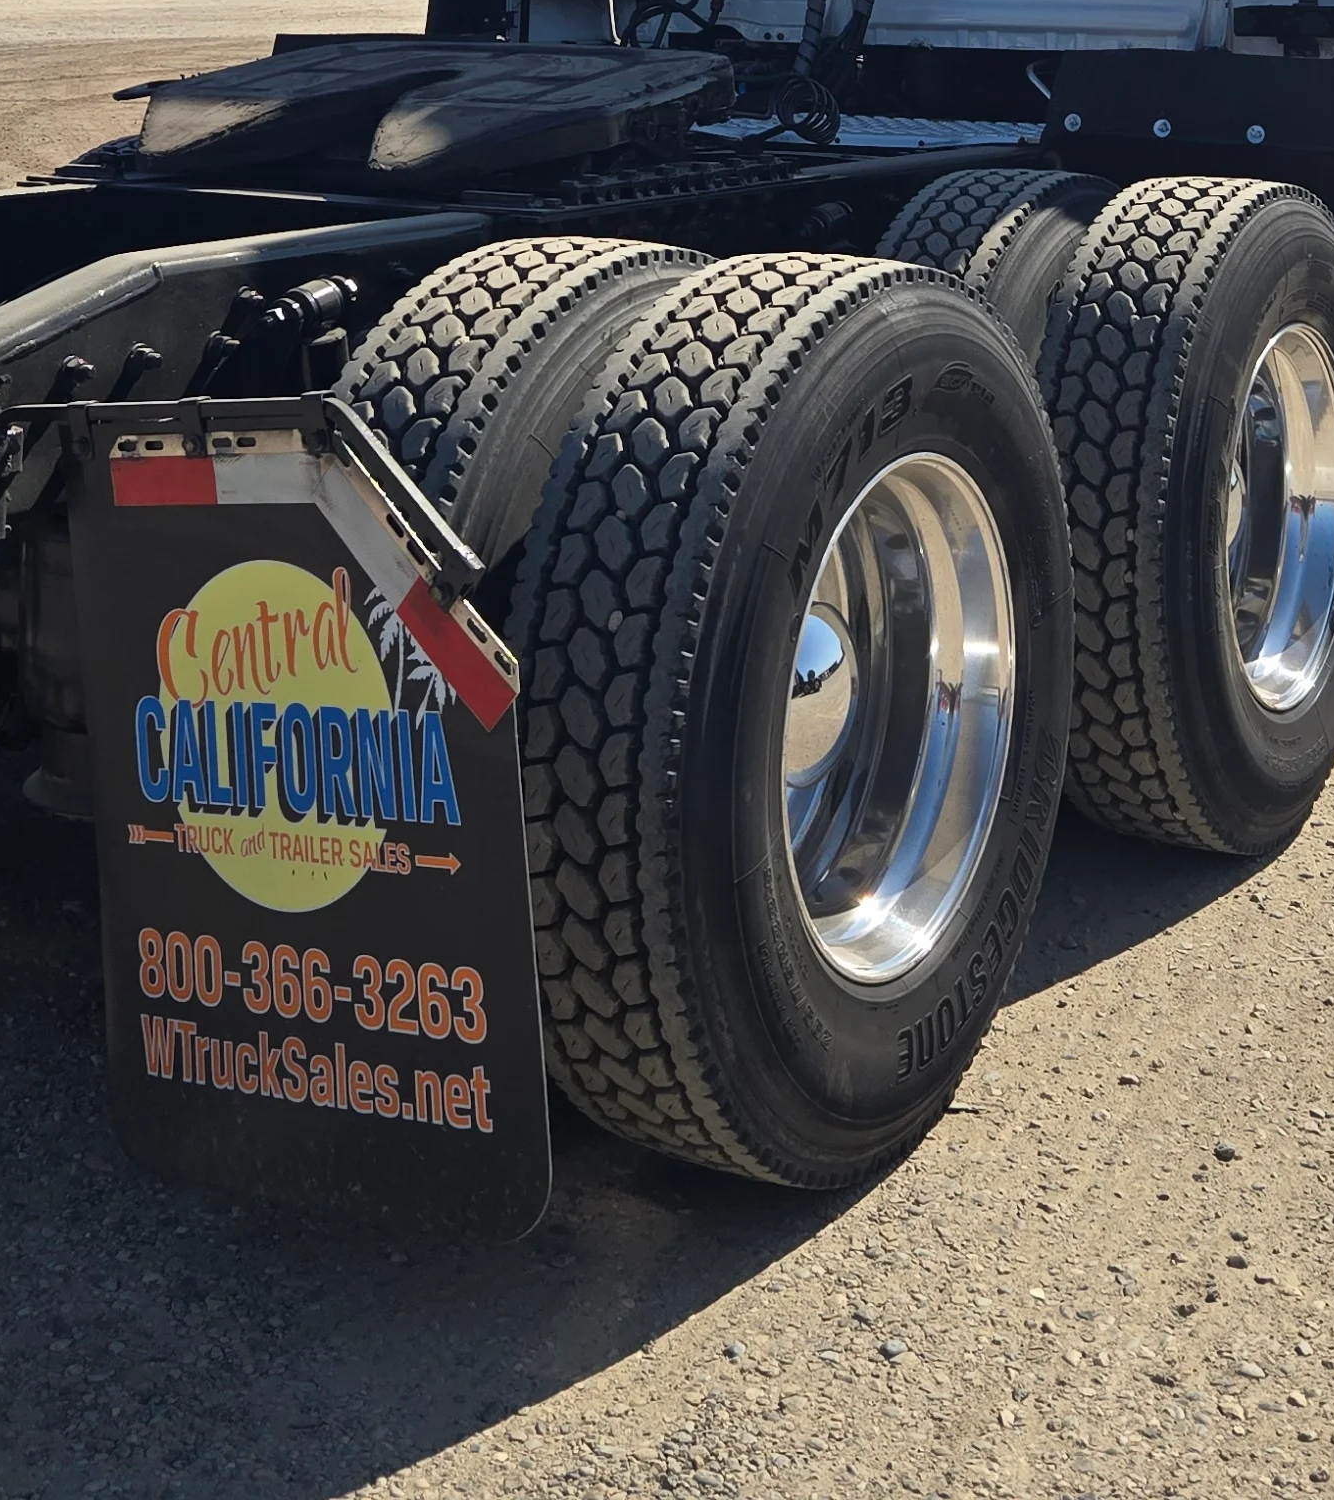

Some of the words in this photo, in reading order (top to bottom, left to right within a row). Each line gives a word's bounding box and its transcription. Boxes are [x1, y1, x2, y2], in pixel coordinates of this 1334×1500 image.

[156, 565, 358, 709] Central
[135, 694, 462, 827] CALIFORNIA
[173, 823, 235, 856] TRUCK
[240, 824, 266, 858] and
[268, 830, 345, 866] TRAILER
[348, 839, 412, 875] SALES
[896, 726, 1065, 1086] BRIDGESTONE
[138, 927, 488, 1045] 800-366-3263
[140, 1013, 494, 1134] WTruckSales.net
